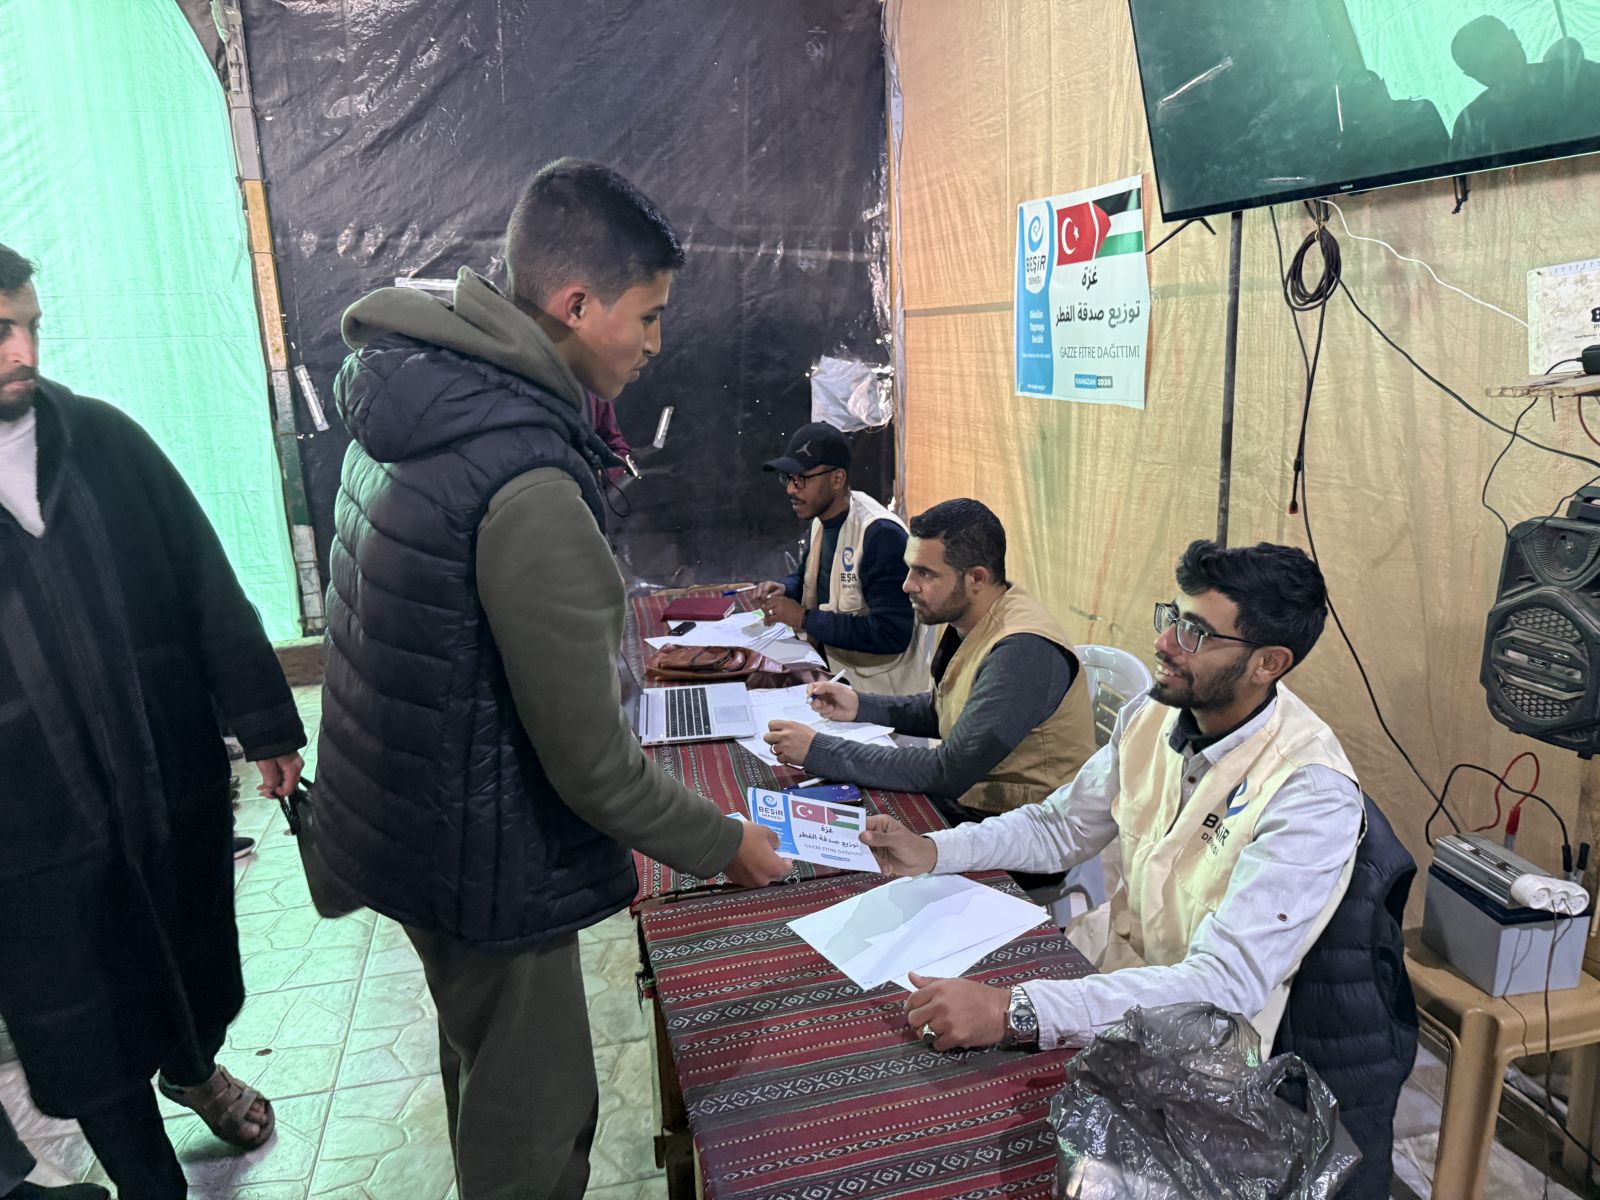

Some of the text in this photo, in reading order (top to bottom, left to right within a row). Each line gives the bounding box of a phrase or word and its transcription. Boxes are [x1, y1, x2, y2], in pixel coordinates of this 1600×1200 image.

[1082, 265, 1098, 291] غزة
[1055, 304, 1075, 326] الفطر
[1078, 302, 1105, 321] صدقة
[1108, 300, 1140, 328] توزيع
[1060, 346, 1077, 358] GAZZE
[1098, 343, 1140, 358] DAĞITIMI
[821, 825, 833, 834] غزة
